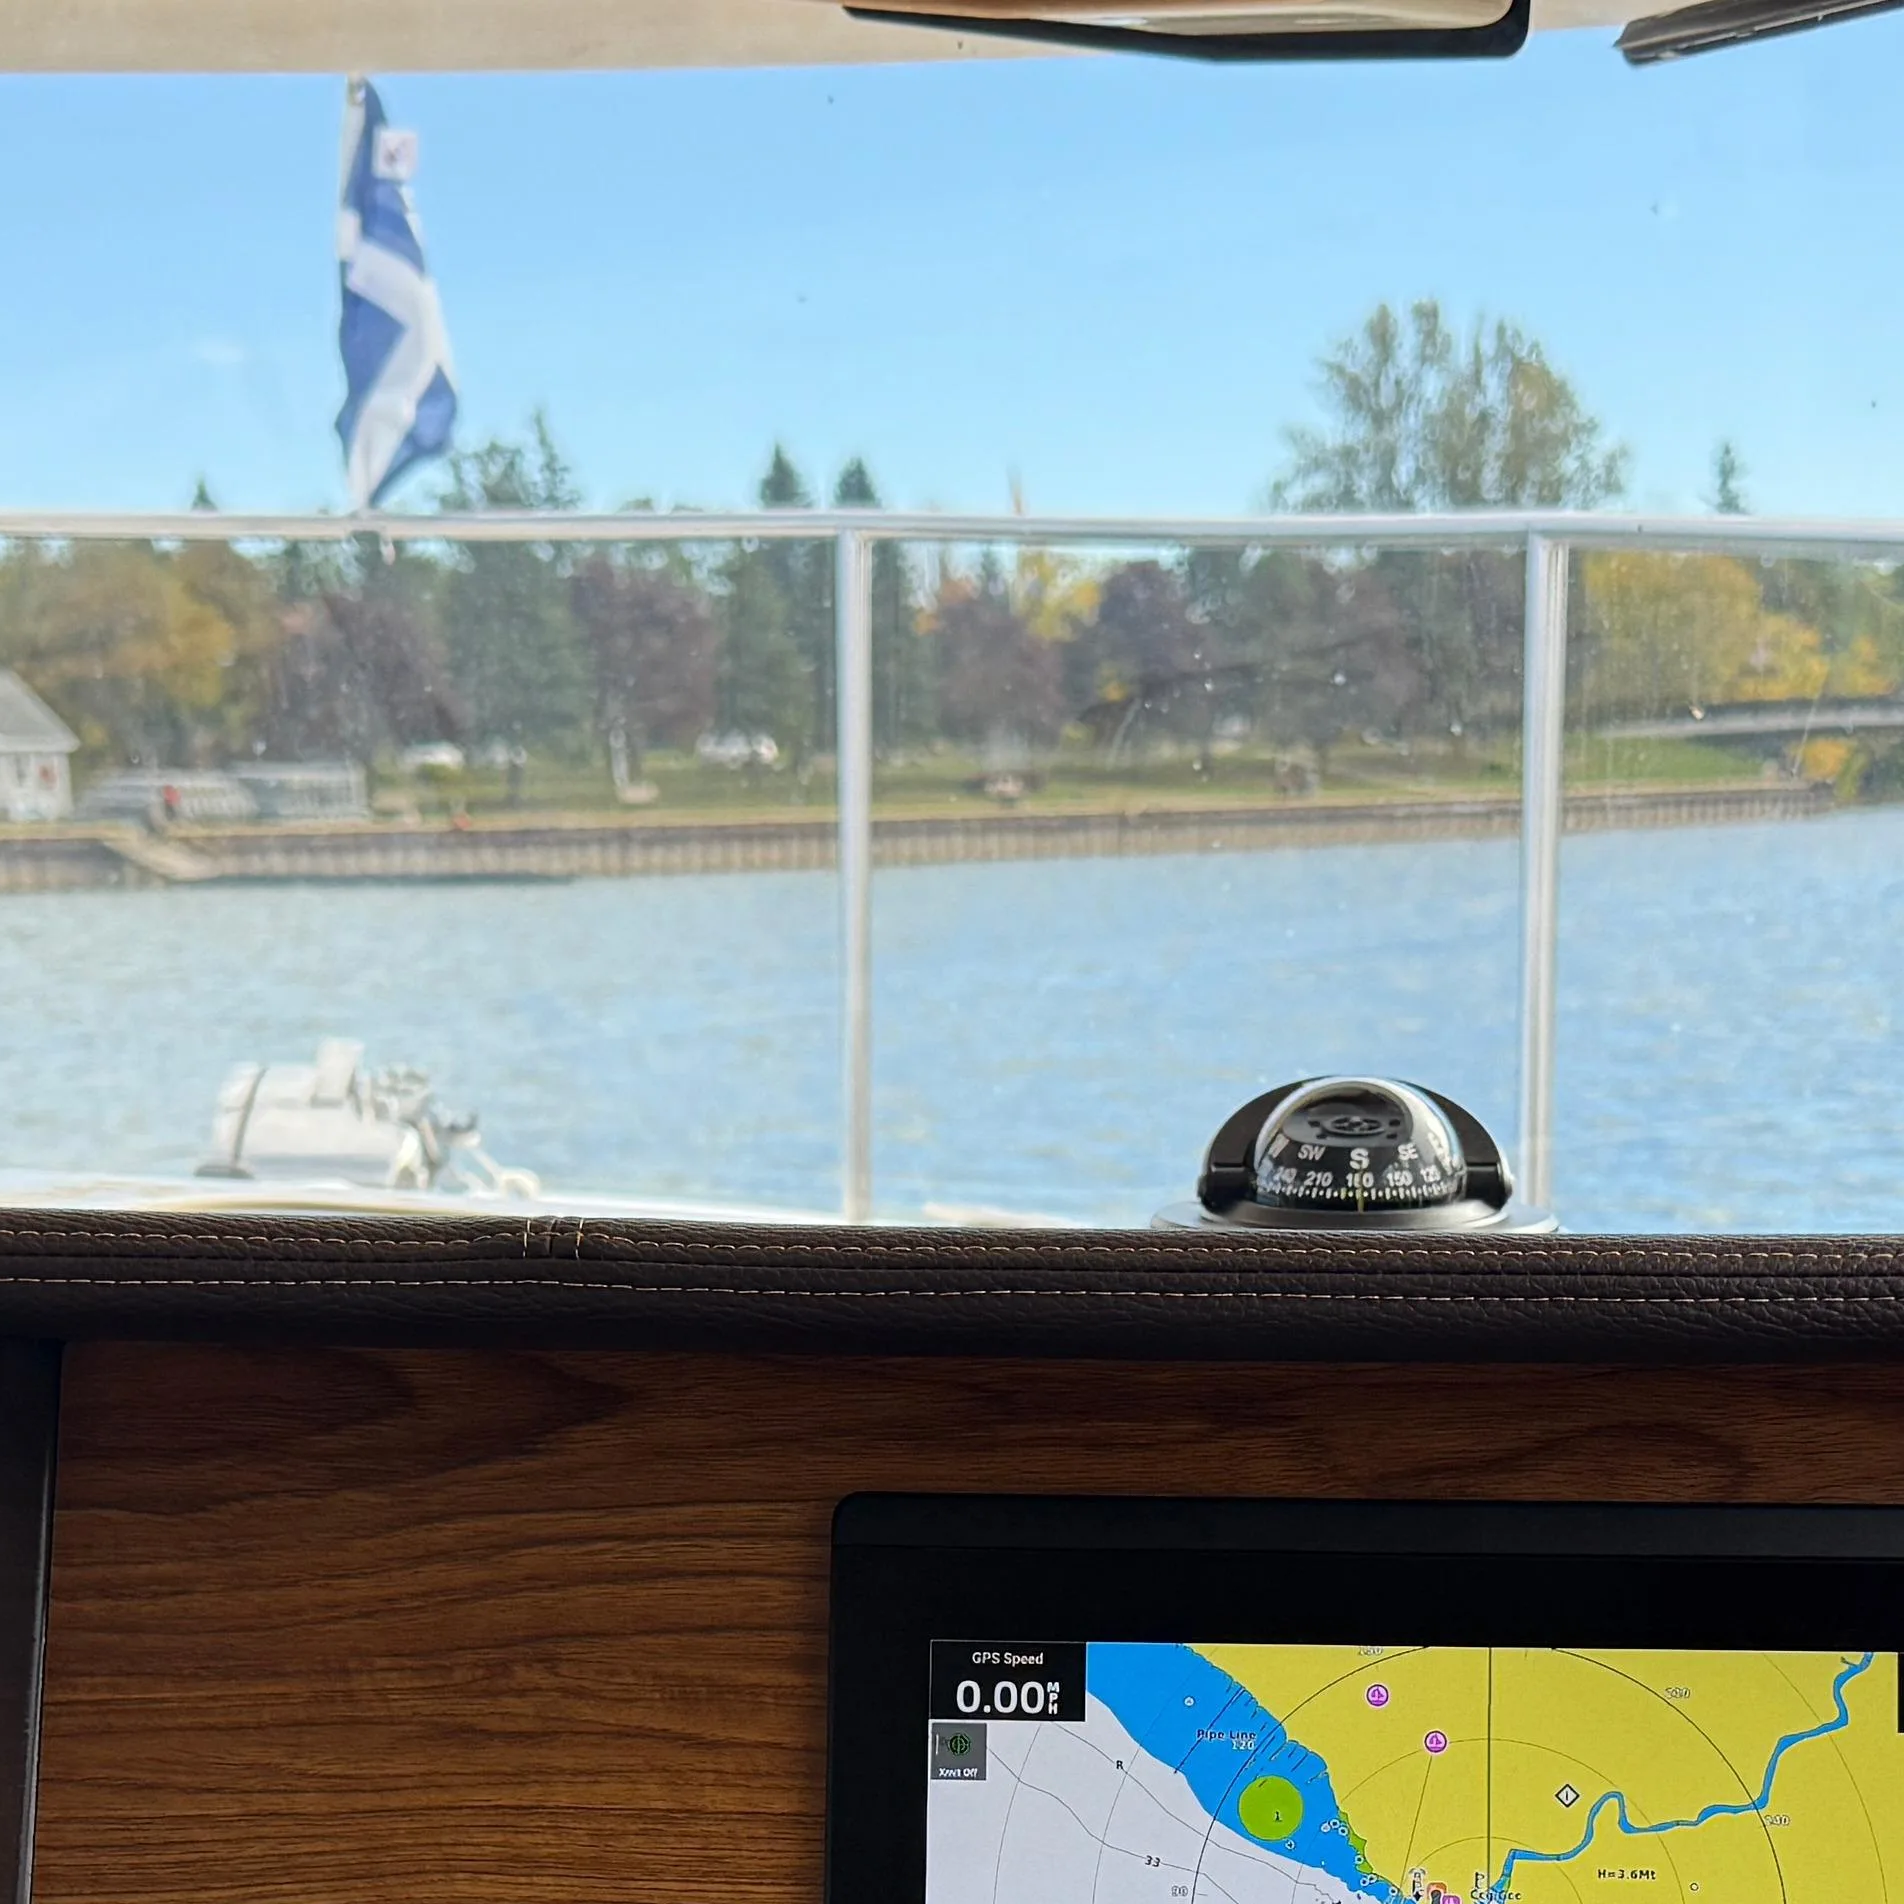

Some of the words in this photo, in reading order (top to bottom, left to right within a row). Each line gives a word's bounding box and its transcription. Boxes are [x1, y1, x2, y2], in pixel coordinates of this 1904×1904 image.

[1298, 1144, 1326, 1160] SW
[1349, 1148, 1370, 1169] S
[1398, 1143, 1418, 1160] SE
[1303, 1171, 1333, 1187] 210
[972, 1652, 1000, 1664] GPS
[1003, 1652, 1044, 1667] Speed
[956, 1680, 1045, 1714] 0.00
[1229, 1730, 1257, 1741] Line
[1144, 1855, 1161, 1867] 33
